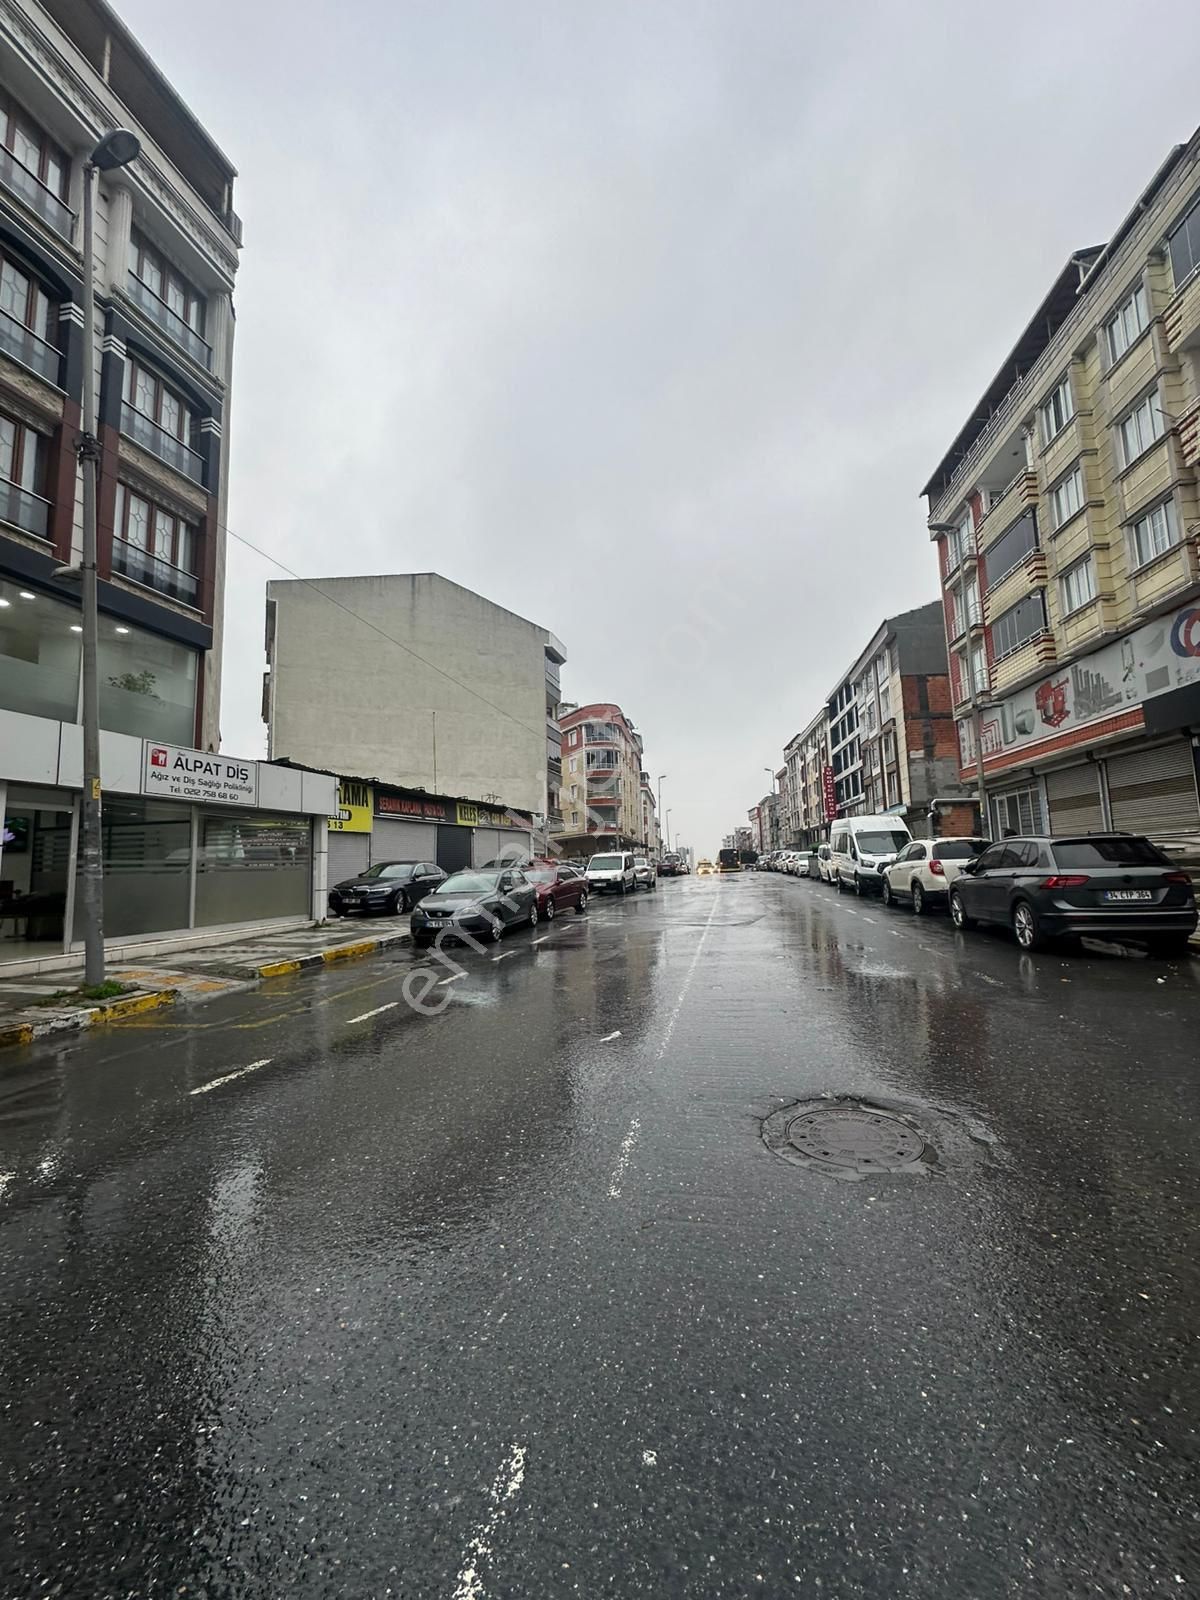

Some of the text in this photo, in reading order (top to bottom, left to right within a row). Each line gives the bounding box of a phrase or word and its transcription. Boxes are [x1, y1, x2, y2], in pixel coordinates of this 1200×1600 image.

[173, 756, 249, 784] ALPAT DİŞ
[150, 771, 169, 781] Ağız
[183, 776, 196, 786] Diş
[198, 778, 221, 789] Sağlığı
[223, 782, 253, 794] Polikliniği
[184, 787, 200, 795] 0212
[202, 790, 216, 798] 758
[218, 791, 228, 799] 68
[229, 793, 239, 801] 60
[334, 821, 343, 829] 13
[1109, 890, 1118, 899] 34
